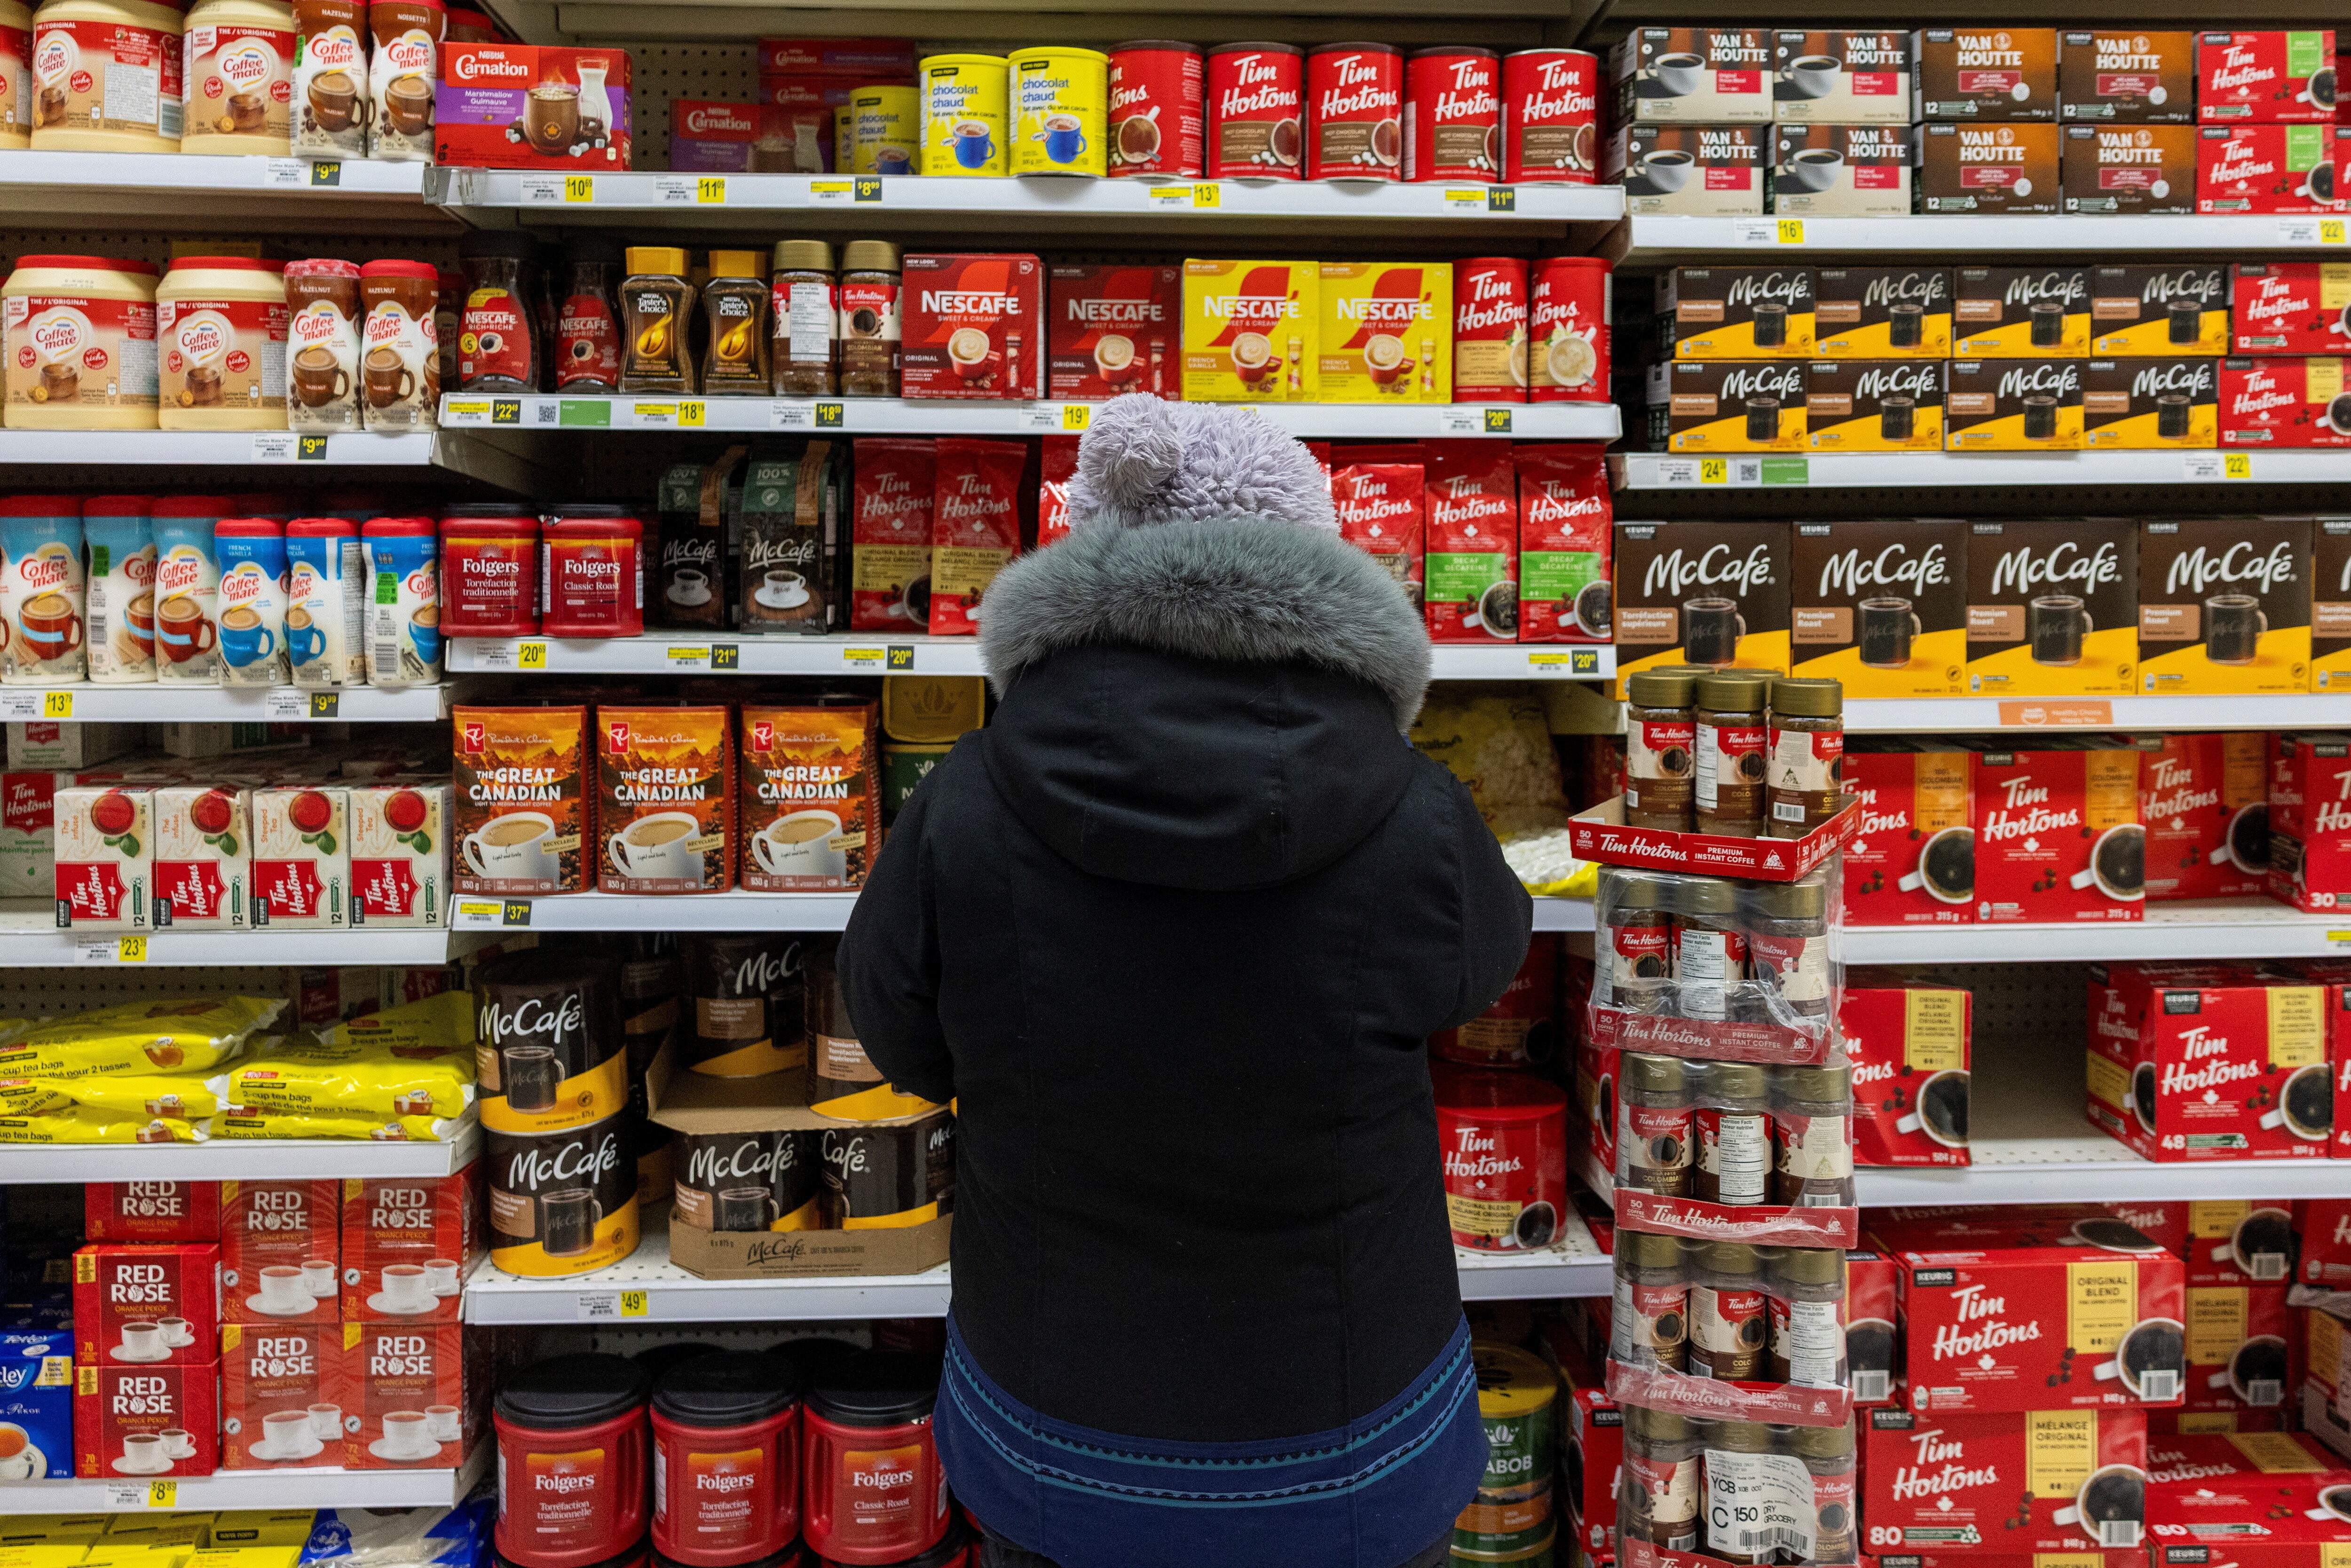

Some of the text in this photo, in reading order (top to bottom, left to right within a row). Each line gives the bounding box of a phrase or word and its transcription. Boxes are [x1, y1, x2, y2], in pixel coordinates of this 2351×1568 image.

[322, 8, 353, 19] HAZELNUT
[397, 13, 426, 23] NOISETTE
[388, 42, 429, 61] Coffee
[1846, 37, 1876, 50] VAN
[2097, 39, 2130, 54] VAN
[38, 49, 68, 70] Coffee
[399, 56, 429, 69] mate
[1846, 51, 1905, 64] HOUTTE
[2097, 55, 2161, 70] HOUTTE
[2222, 46, 2254, 67] Tim
[42, 59, 67, 74] mate
[1450, 60, 1489, 90] Tim
[465, 90, 513, 98] Marshmallow
[932, 85, 978, 95] chocolat
[932, 98, 964, 108] chaud
[1435, 90, 1499, 122] Horton
[1700, 132, 1730, 145] VAN
[1700, 145, 1758, 159] HOUTTE
[296, 316, 334, 335] Coffee
[304, 327, 334, 341] mate
[1856, 366, 1934, 399] McCafé
[875, 472, 910, 494] Tim
[1445, 474, 1482, 499] Tim
[863, 495, 932, 519] Hortons
[749, 539, 813, 569] McCafé
[565, 559, 620, 577] Folgers
[1820, 543, 1946, 597] McCafé
[2166, 541, 2292, 595] McCafé
[221, 575, 260, 595] Coffee
[565, 582, 619, 591] Classic Roast
[229, 587, 260, 602] mate
[476, 767, 555, 784] THE GREAT
[757, 783, 848, 799] CANADIAN
[2000, 776, 2049, 809] Tim
[260, 808, 270, 843] Steeped
[270, 816, 278, 833] Tea
[1984, 808, 2079, 843] Hortons
[1600, 833, 1687, 861] Tim Hortons
[1695, 853, 1755, 865] INSTANT COFFEE
[90, 865, 108, 918] Hortons
[2310, 893, 2335, 907] 30
[331, 913, 342, 925] 12
[1623, 1020, 1712, 1047] Tim Hortons
[1732, 1032, 1769, 1040] PREMIUM
[1753, 1040, 1781, 1049] COFFEE
[2178, 1025, 2228, 1061] Tim
[41, 1061, 64, 1070] bags
[2161, 1059, 2259, 1095] Hortons
[2161, 1135, 2185, 1150] 48
[509, 1133, 616, 1190] McCafé
[254, 1191, 302, 1211] RED
[1630, 1199, 1643, 1208] 50
[248, 1211, 308, 1231] ROSE
[747, 1238, 804, 1266] McCafé
[2085, 1287, 2120, 1296] BLEND
[377, 1336, 426, 1356] RED
[370, 1356, 433, 1377] ROSE
[119, 1377, 166, 1396] RED
[113, 1396, 174, 1415] ROSE
[2035, 1419, 2088, 1431] MÉLANGE
[2035, 1432, 2088, 1442] ORIGINAL
[1910, 1429, 1963, 1466] Tim
[1485, 1454, 1532, 1474] ABOB
[853, 1471, 914, 1491] Folgers
[1711, 1476, 1736, 1494] YCB
[1893, 1464, 1997, 1501] Hortons
[540, 1500, 590, 1512] Torréfaction
[854, 1498, 910, 1511] Classic Roast
[536, 1508, 592, 1521] traditionnelle
[1712, 1507, 1758, 1529] C 150
[1764, 1515, 1797, 1525] GROCERY
[1870, 1527, 1902, 1546] 80
